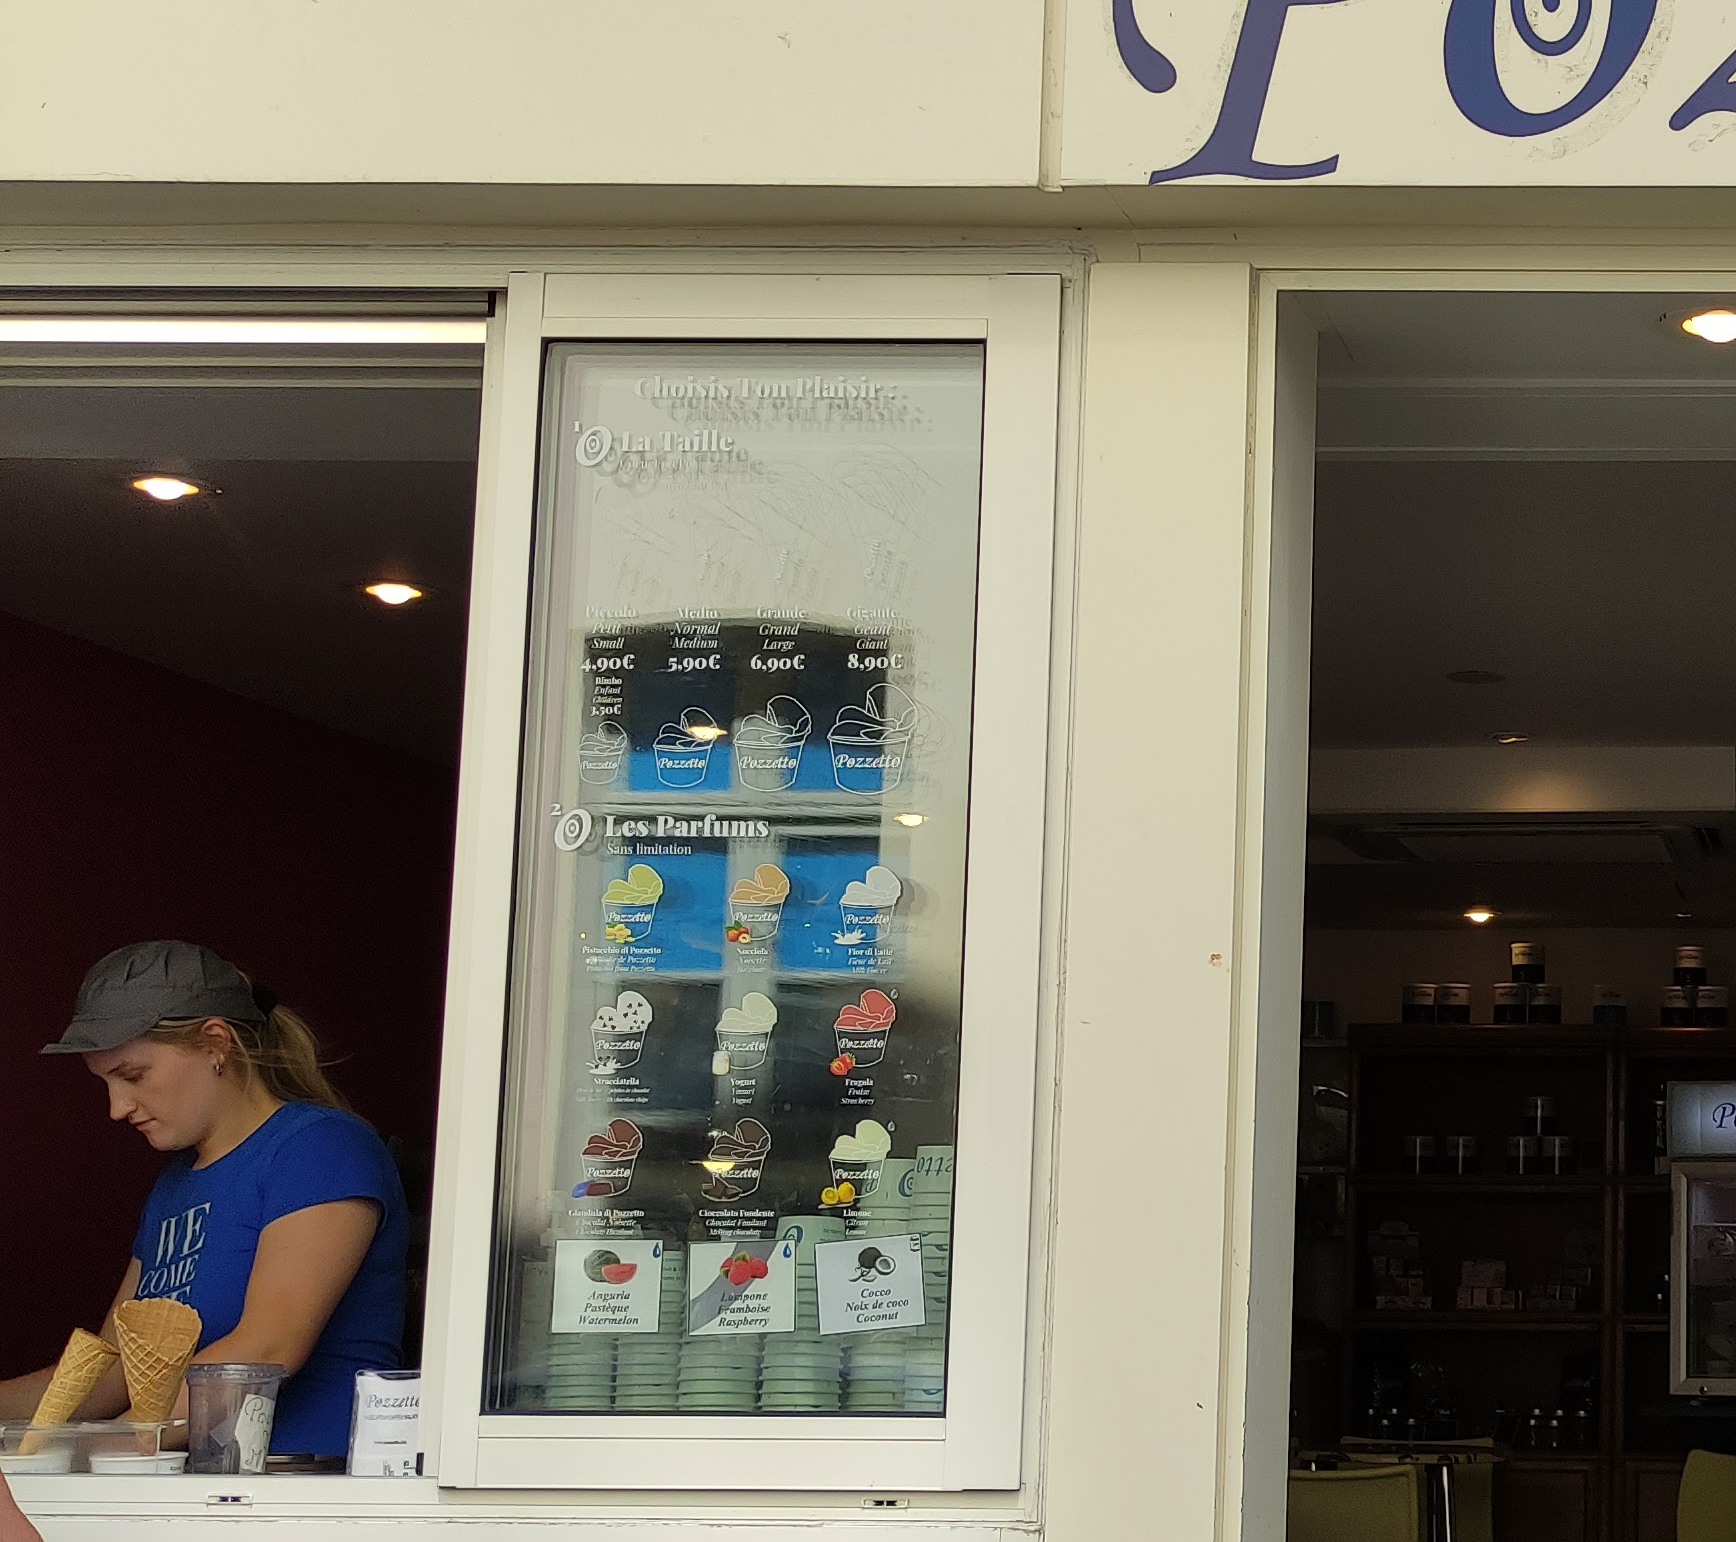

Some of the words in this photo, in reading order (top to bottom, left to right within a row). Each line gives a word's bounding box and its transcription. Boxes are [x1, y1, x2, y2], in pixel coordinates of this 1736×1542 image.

[621, 430, 651, 452] La
[658, 429, 735, 453] Taille
[669, 621, 722, 636] Normal
[758, 622, 800, 637] Grand
[590, 636, 626, 650] Small
[671, 636, 719, 649] Medium
[761, 638, 796, 653] Large
[856, 637, 889, 650] Giant
[580, 653, 636, 673] 4,90€
[667, 653, 722, 673] 5,90€
[750, 653, 806, 673] 6,90€
[846, 652, 904, 672] 8,90€
[657, 757, 706, 770] Pozzetto
[740, 756, 798, 770] Pozzetto
[835, 753, 901, 770] Pozzetto
[550, 803, 562, 816] 2
[603, 814, 650, 838] Les
[655, 813, 770, 838] Parfums
[606, 842, 634, 855] Sans
[635, 841, 692, 856] limitation
[586, 1166, 632, 1179] Pozzetto
[834, 1168, 881, 1180] Pozzetto
[155, 1201, 212, 1268] WE
[137, 1254, 199, 1297] COME
[587, 1290, 632, 1304] Anguria
[859, 1288, 892, 1299] Cocco
[717, 1302, 772, 1314] Framboise
[845, 1301, 871, 1313] Noix
[871, 1300, 885, 1311] de
[885, 1298, 910, 1309] coco
[578, 1314, 640, 1326] Watermelon
[717, 1315, 770, 1328] Raspberry
[855, 1311, 900, 1324] Coconut
